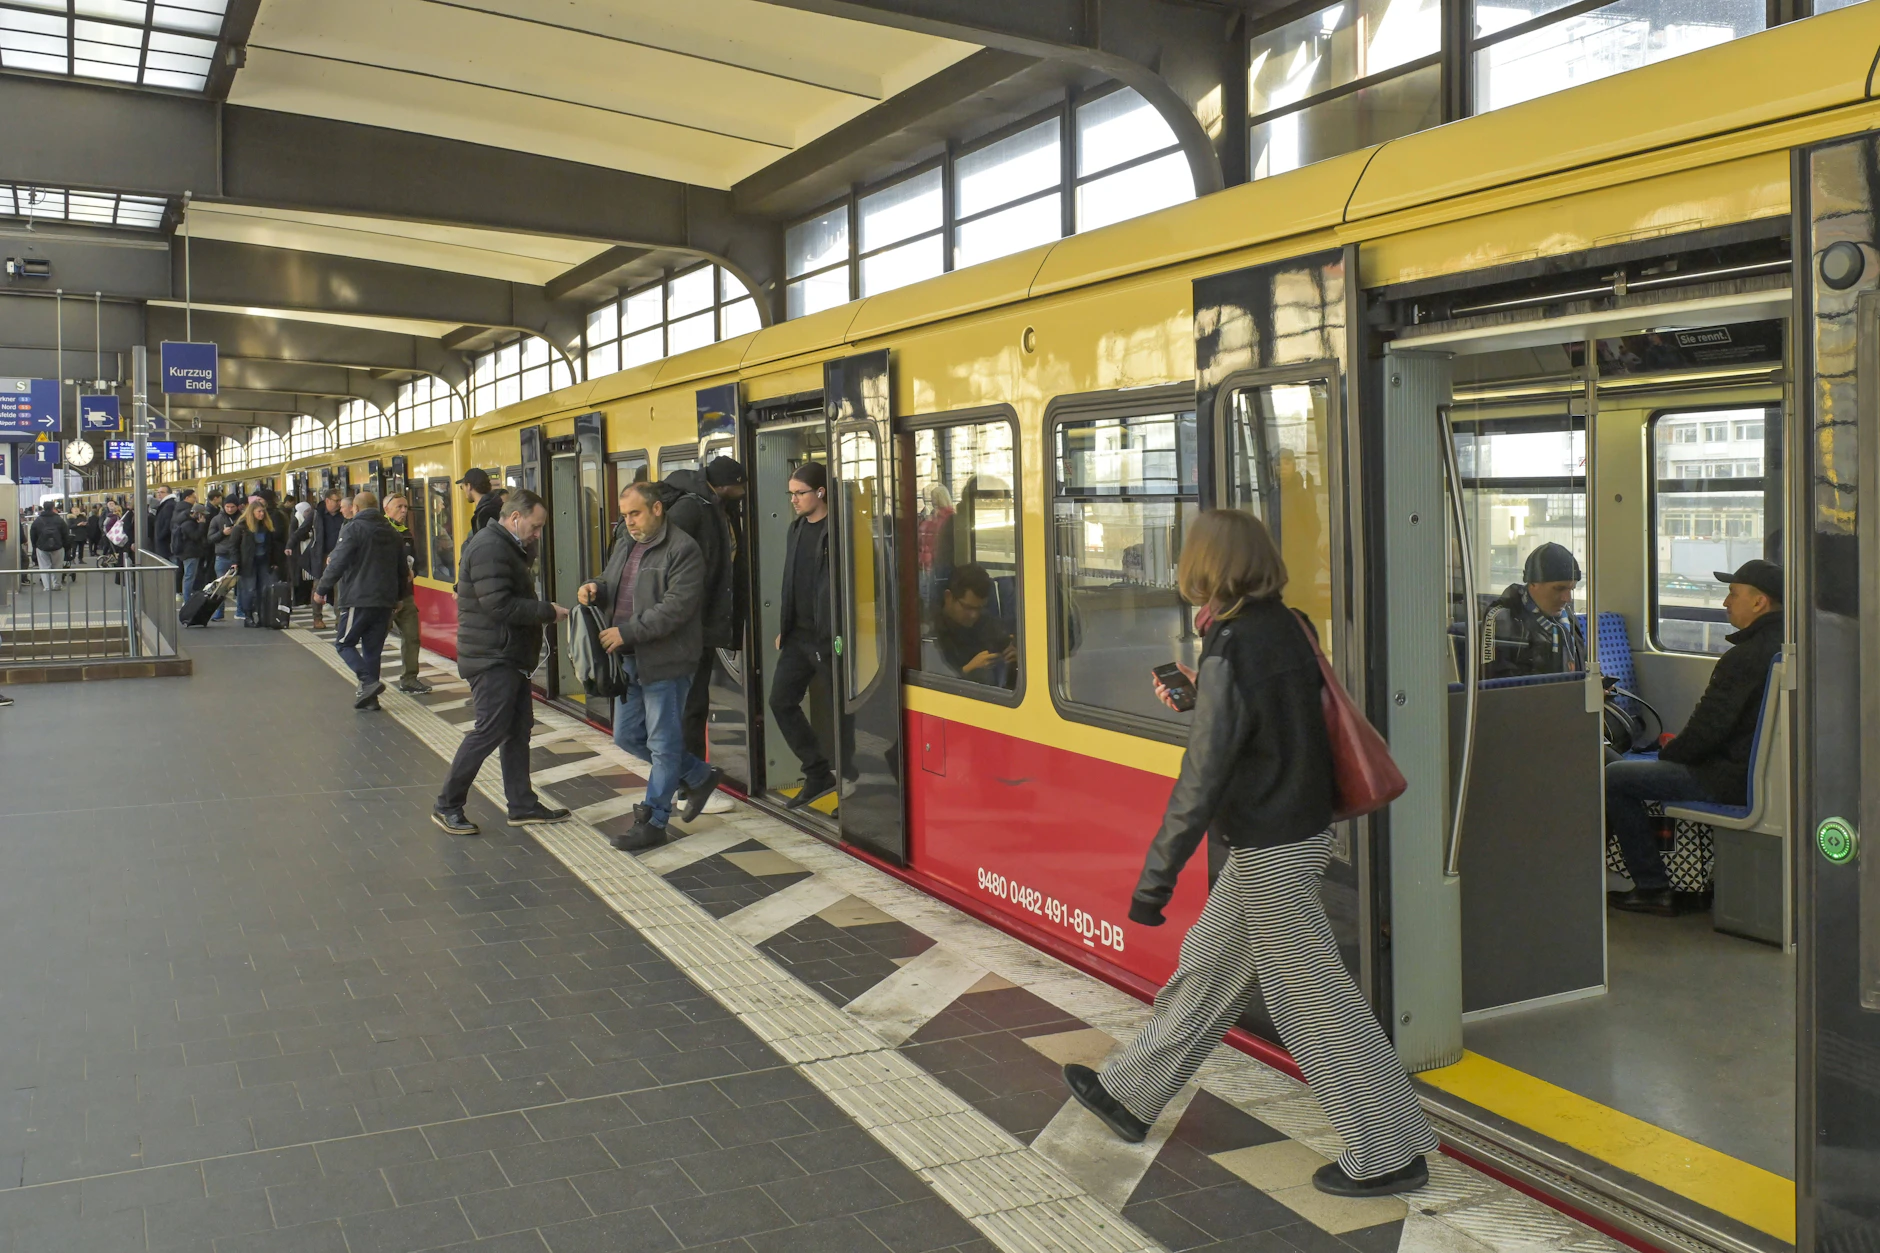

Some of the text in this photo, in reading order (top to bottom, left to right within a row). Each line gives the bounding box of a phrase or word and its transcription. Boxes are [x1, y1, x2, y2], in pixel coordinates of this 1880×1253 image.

[1680, 331, 1728, 345] Sie rennt.
[169, 366, 212, 380] Kurzzug
[185, 380, 212, 390] Ende
[977, 867, 1007, 899] 9480
[1009, 880, 1043, 916] 0482
